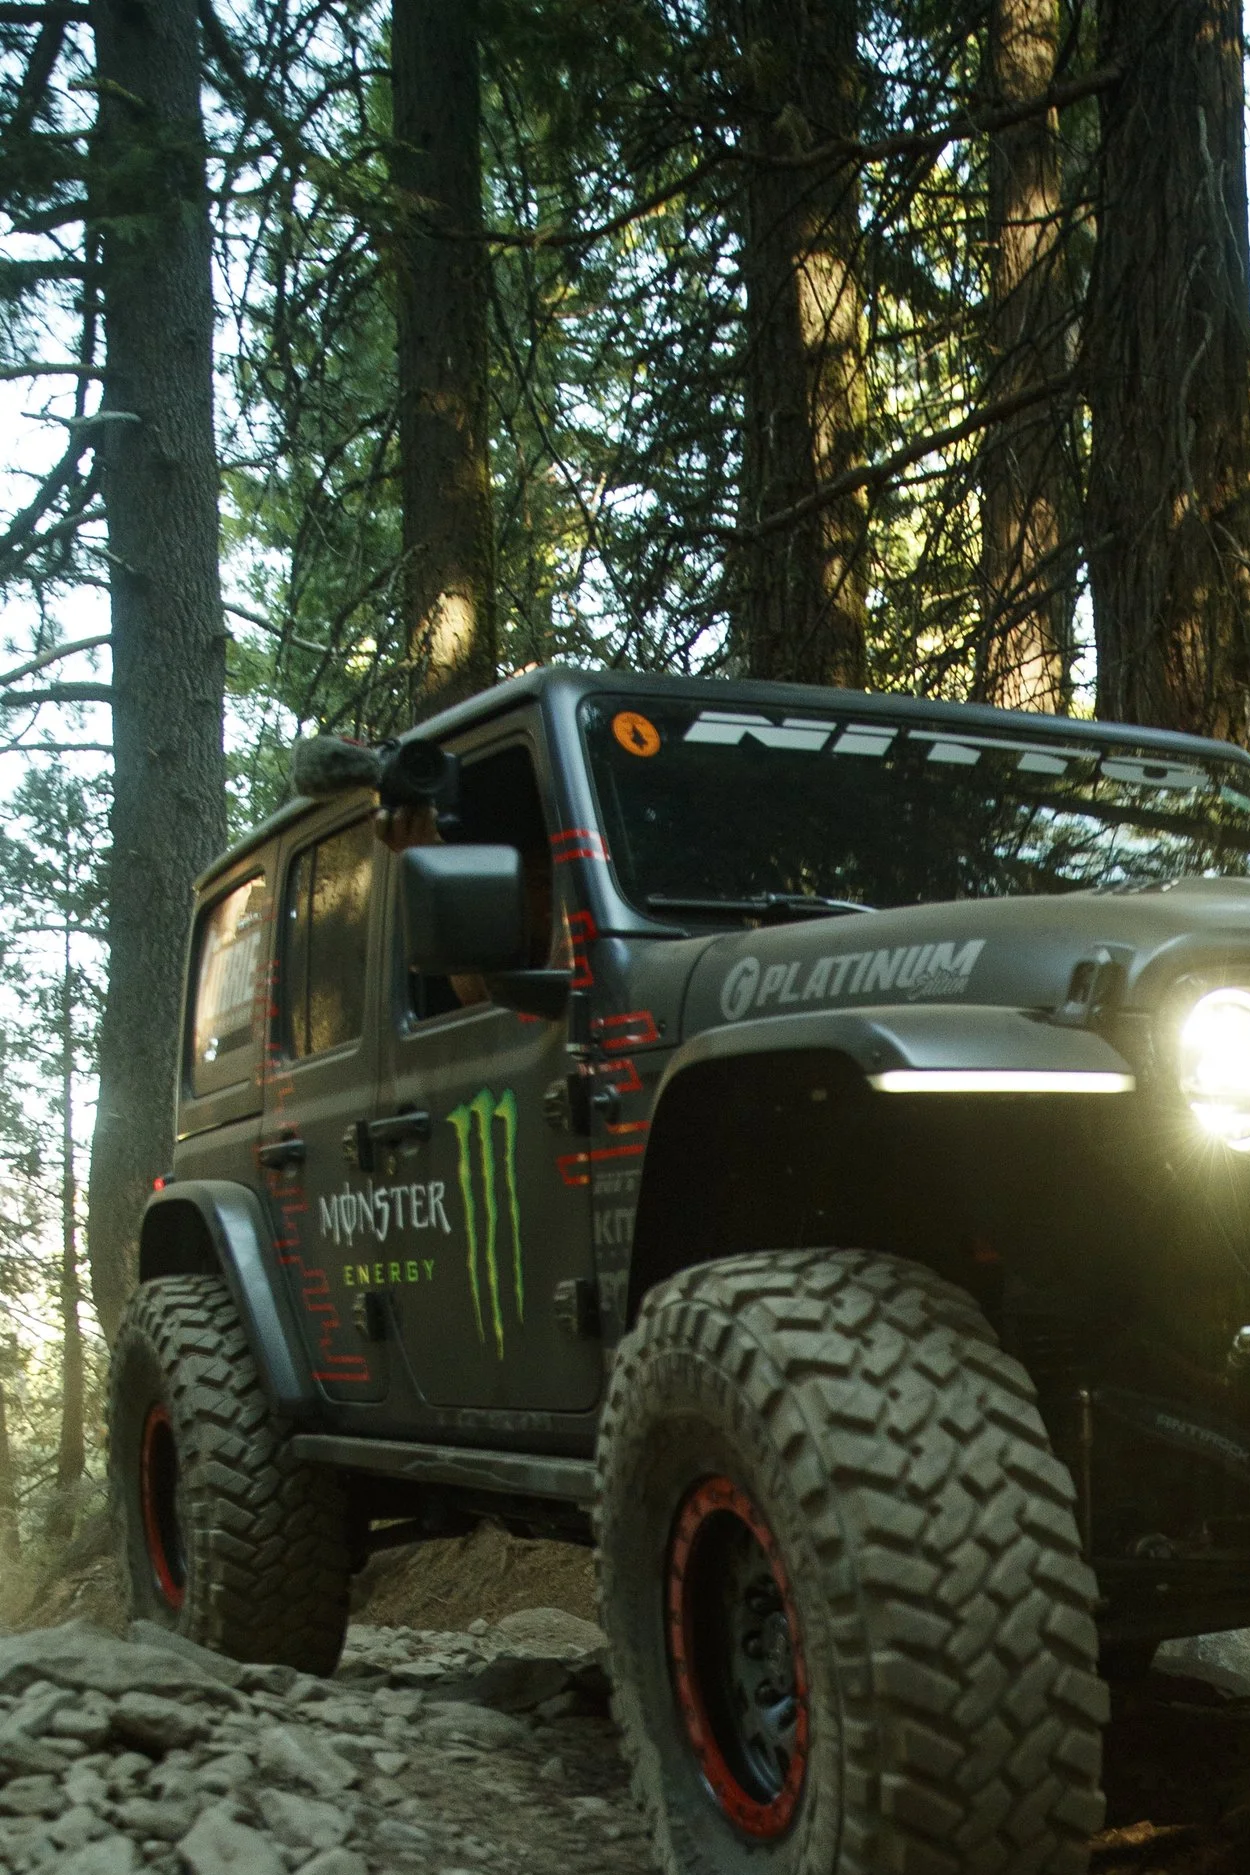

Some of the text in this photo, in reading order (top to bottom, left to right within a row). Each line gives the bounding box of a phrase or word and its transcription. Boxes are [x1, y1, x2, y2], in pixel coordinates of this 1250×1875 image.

[685, 711, 1209, 788] NITTO
[756, 939, 986, 1006] PLATINUM
[319, 1178, 452, 1246] MONSTER
[343, 1258, 435, 1287] ENERGY
